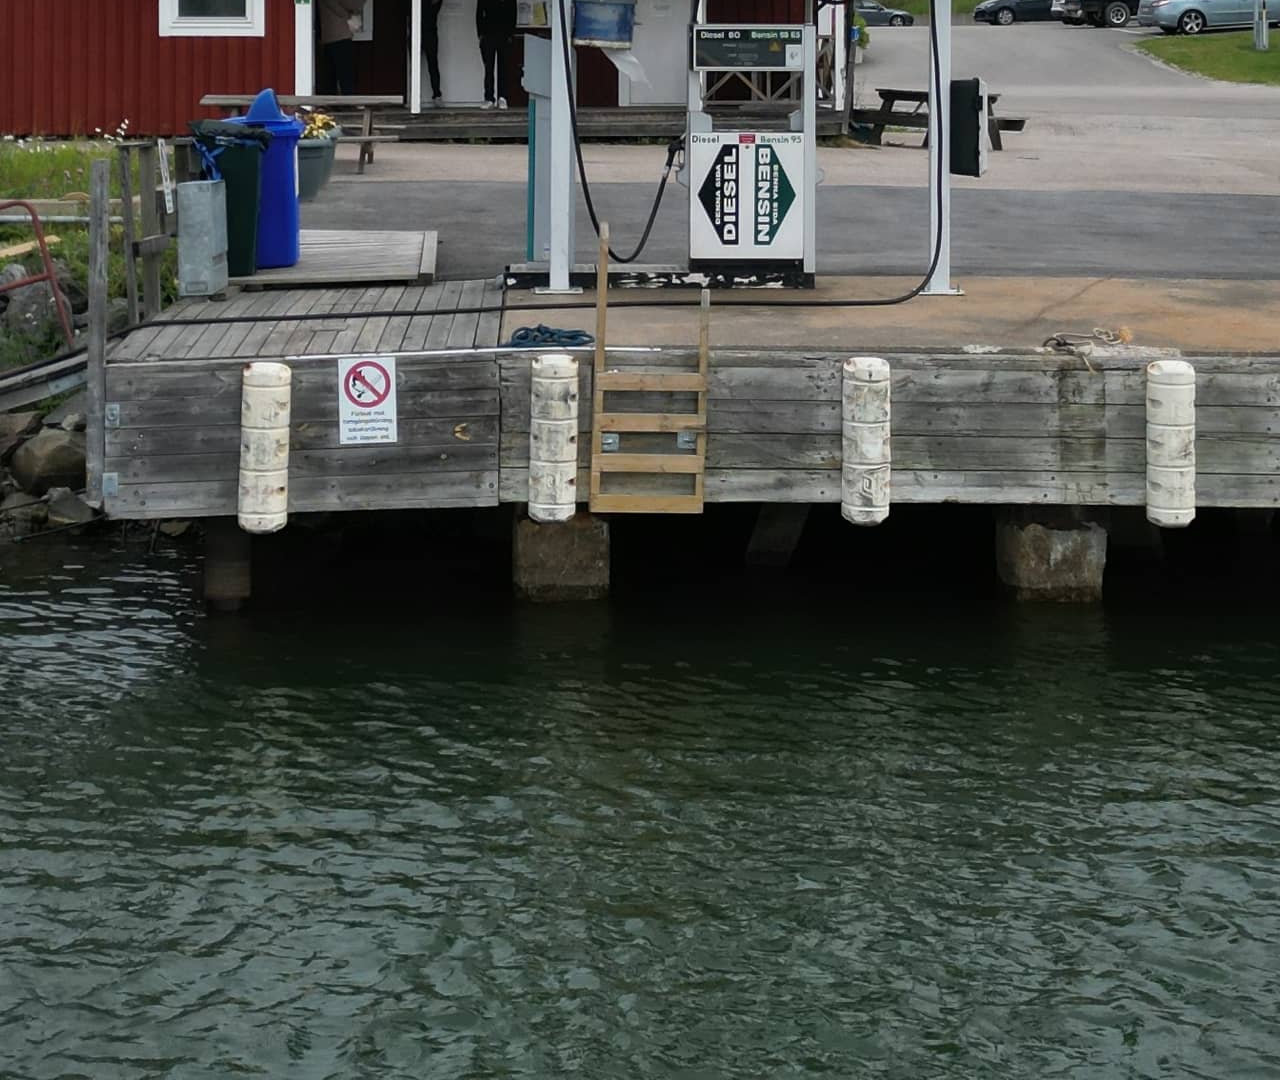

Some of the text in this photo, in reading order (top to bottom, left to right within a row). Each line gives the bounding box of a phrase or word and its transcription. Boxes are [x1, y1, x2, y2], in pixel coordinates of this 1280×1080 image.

[701, 31, 725, 39] Diesel
[751, 31, 778, 39] Bensin
[691, 135, 720, 144] Diesel
[760, 135, 789, 144] Bensin
[790, 135, 802, 144] 95
[723, 147, 737, 241] DIESEL
[757, 147, 771, 242] BENSIN
